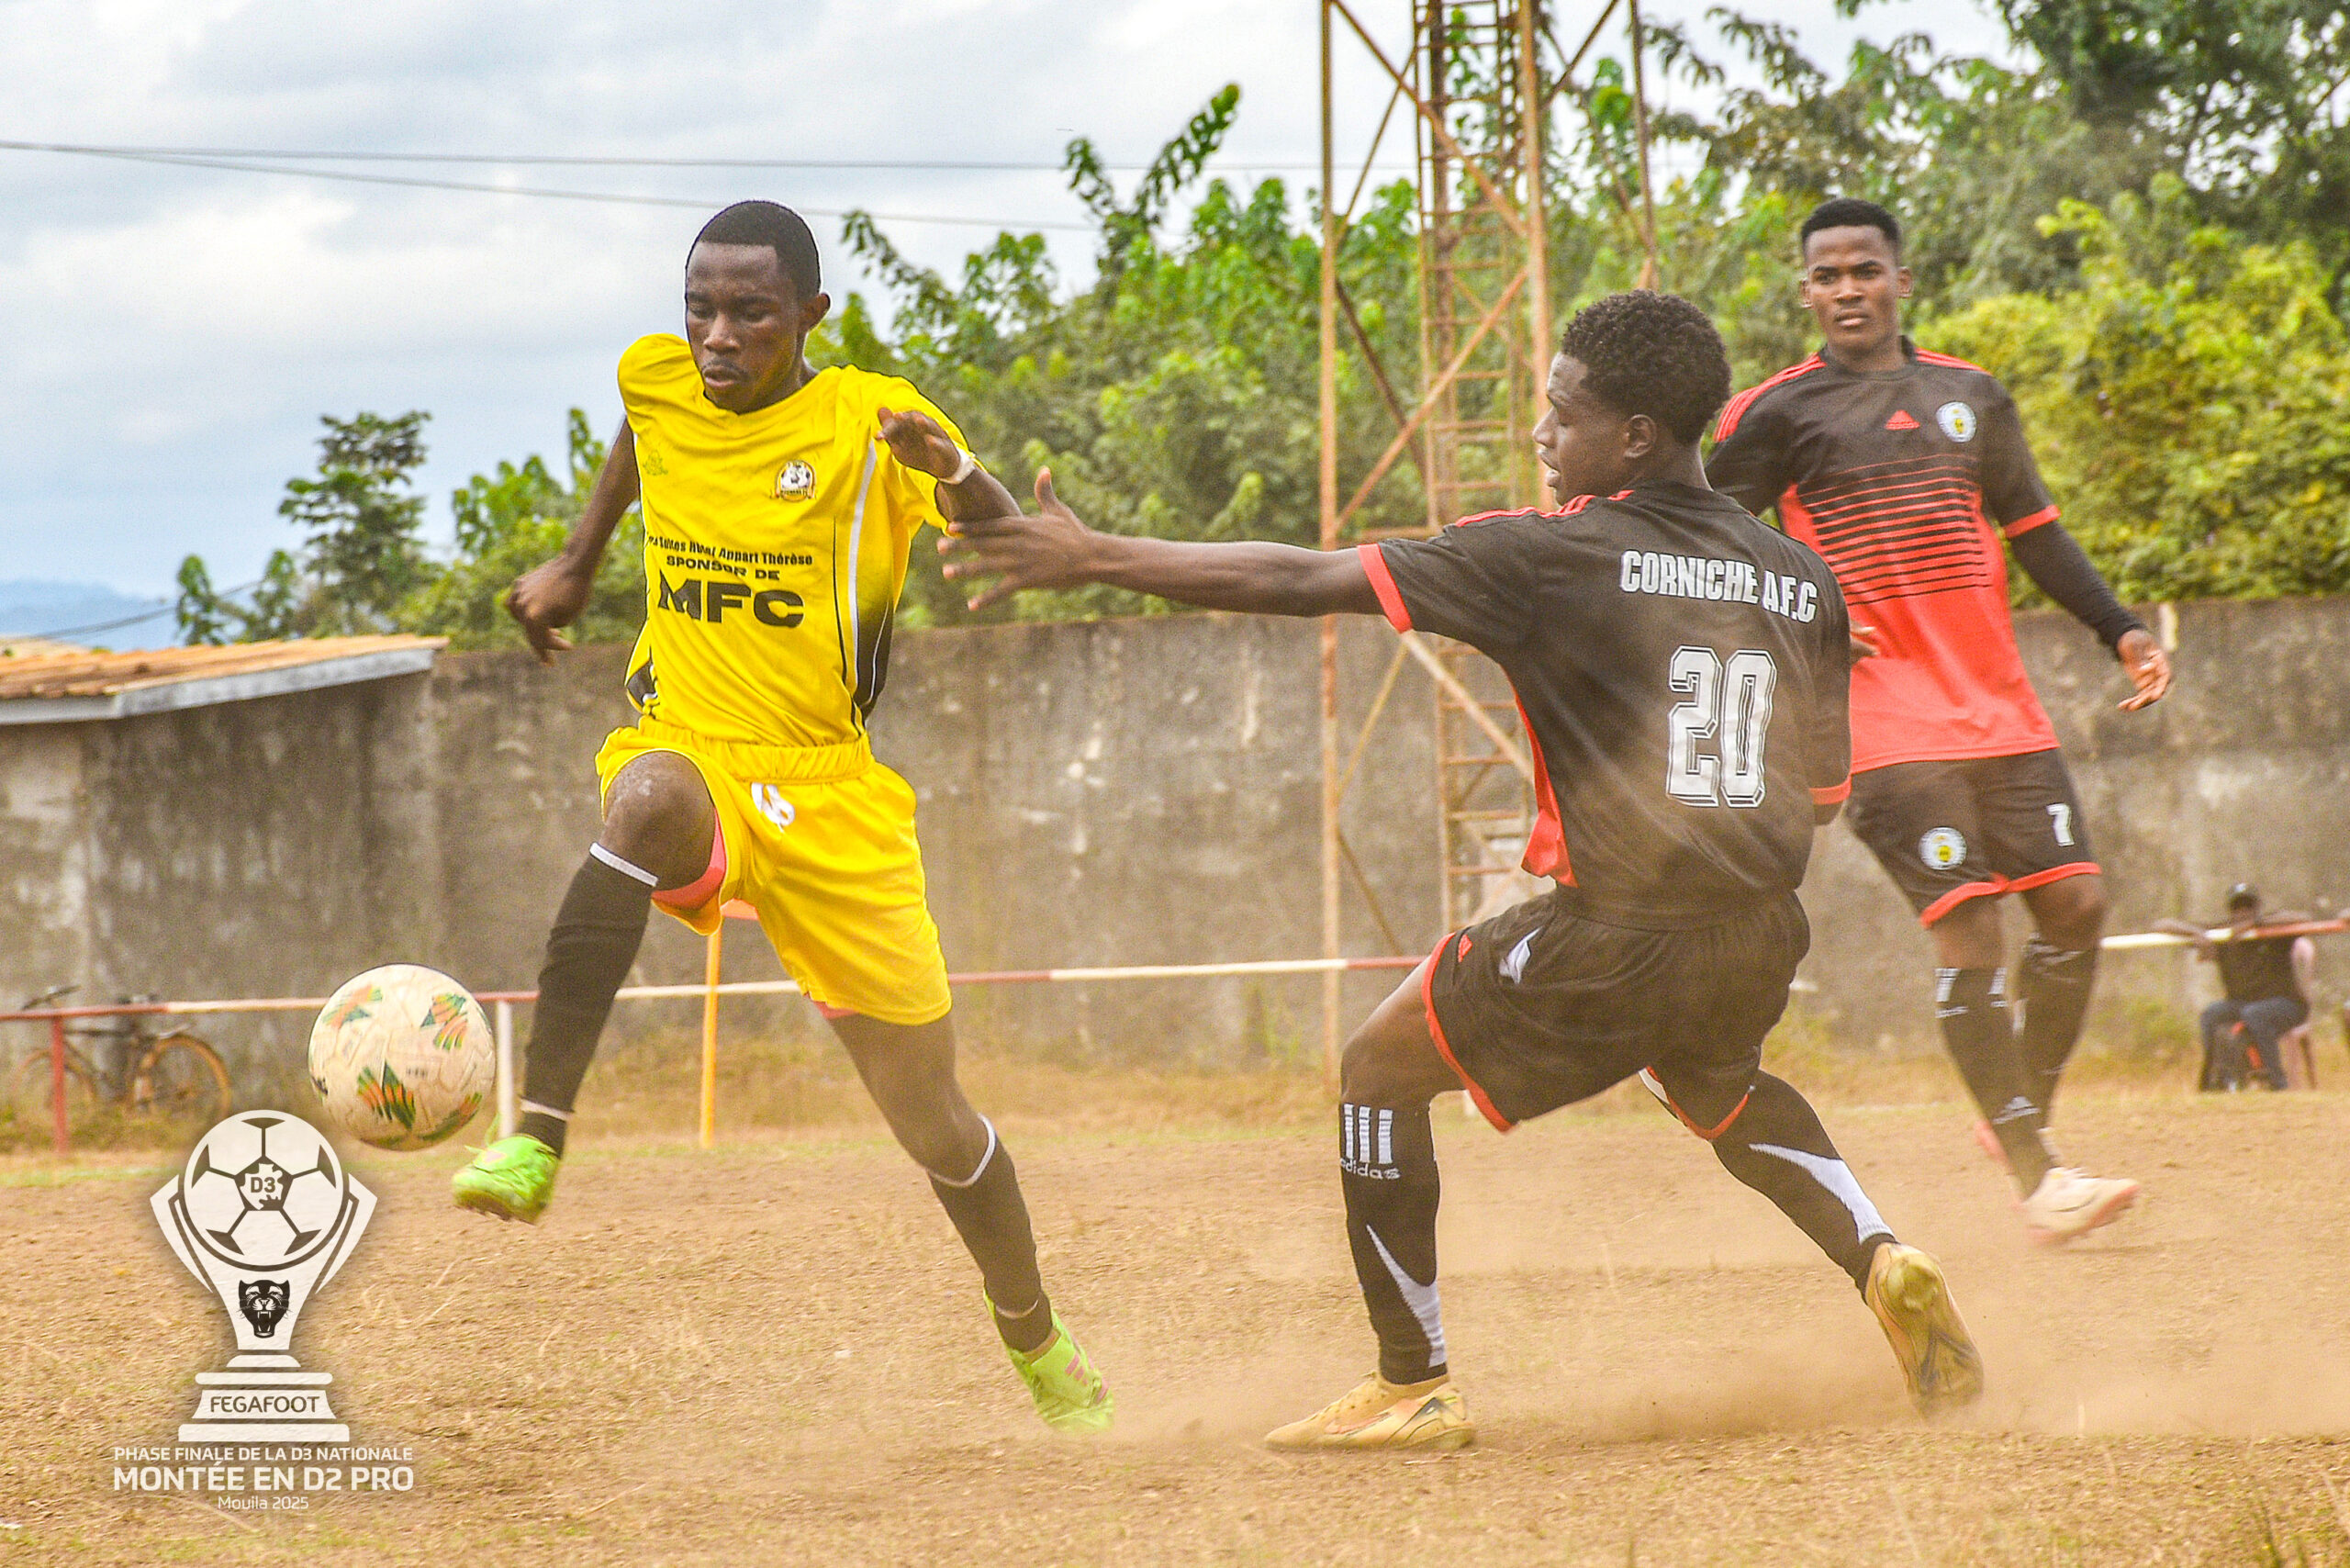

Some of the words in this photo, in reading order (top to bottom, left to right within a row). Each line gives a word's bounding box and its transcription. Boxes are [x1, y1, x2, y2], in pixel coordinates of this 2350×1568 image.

[666, 554, 747, 577] SPONSOR
[755, 569, 780, 581] DE
[718, 547, 759, 564] Appart
[1620, 550, 1759, 605] CORNICHE
[656, 567, 805, 629] MFC
[1665, 644, 1778, 809] 20
[2045, 801, 2076, 847] 7
